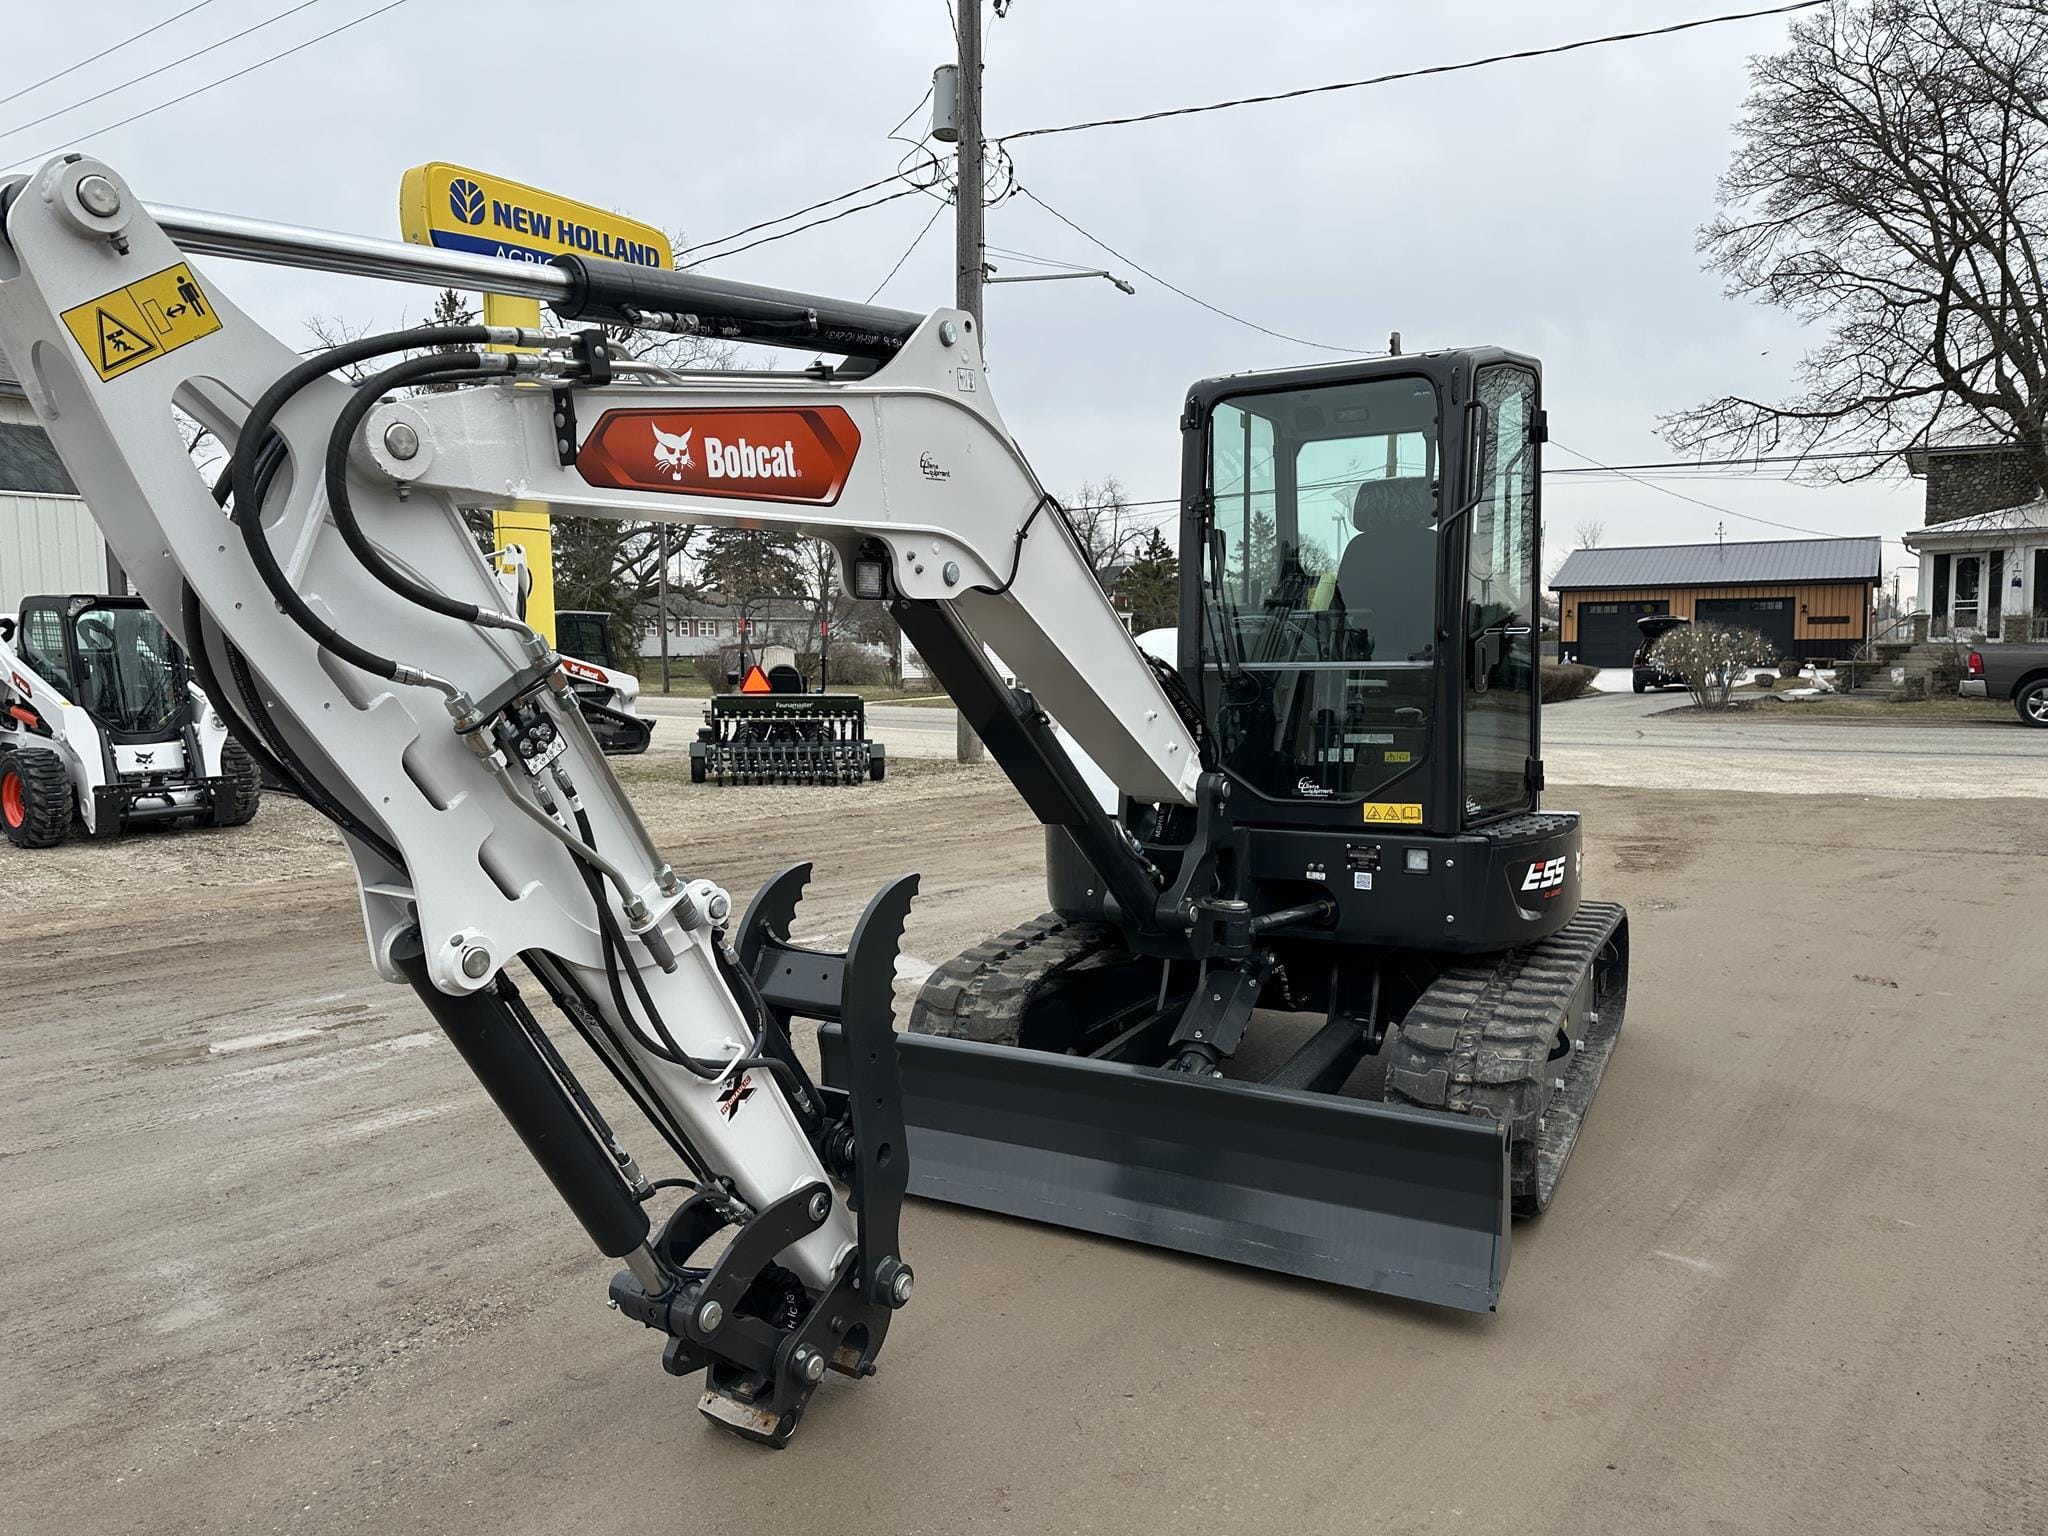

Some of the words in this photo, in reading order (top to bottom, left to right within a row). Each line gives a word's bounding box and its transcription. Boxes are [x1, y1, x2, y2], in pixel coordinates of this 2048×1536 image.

[493, 200, 551, 240] NEW
[557, 219, 660, 268] HOLLAND
[703, 437, 798, 479] Bobcat
[1520, 855, 1567, 891] E55
[720, 1075, 752, 1116] HYDRAULIC
